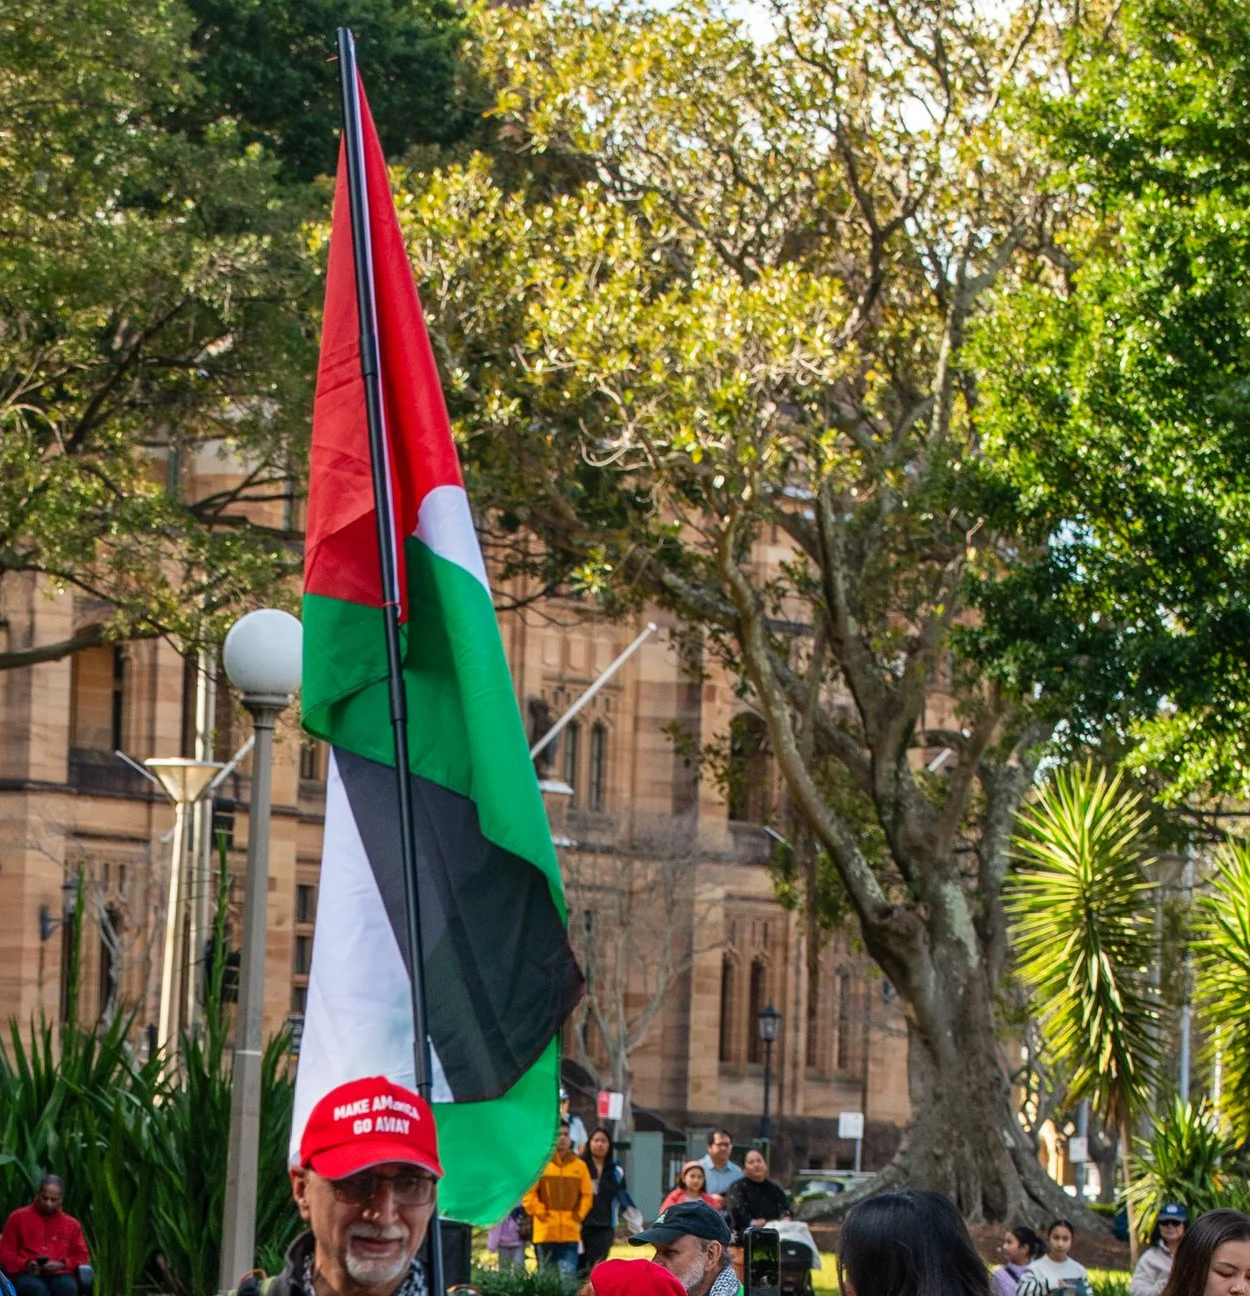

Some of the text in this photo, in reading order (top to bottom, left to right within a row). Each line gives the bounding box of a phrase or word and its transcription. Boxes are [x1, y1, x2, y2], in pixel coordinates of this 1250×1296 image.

[333, 1098, 370, 1121] MAKE
[353, 1116, 410, 1135] GO AWAY
